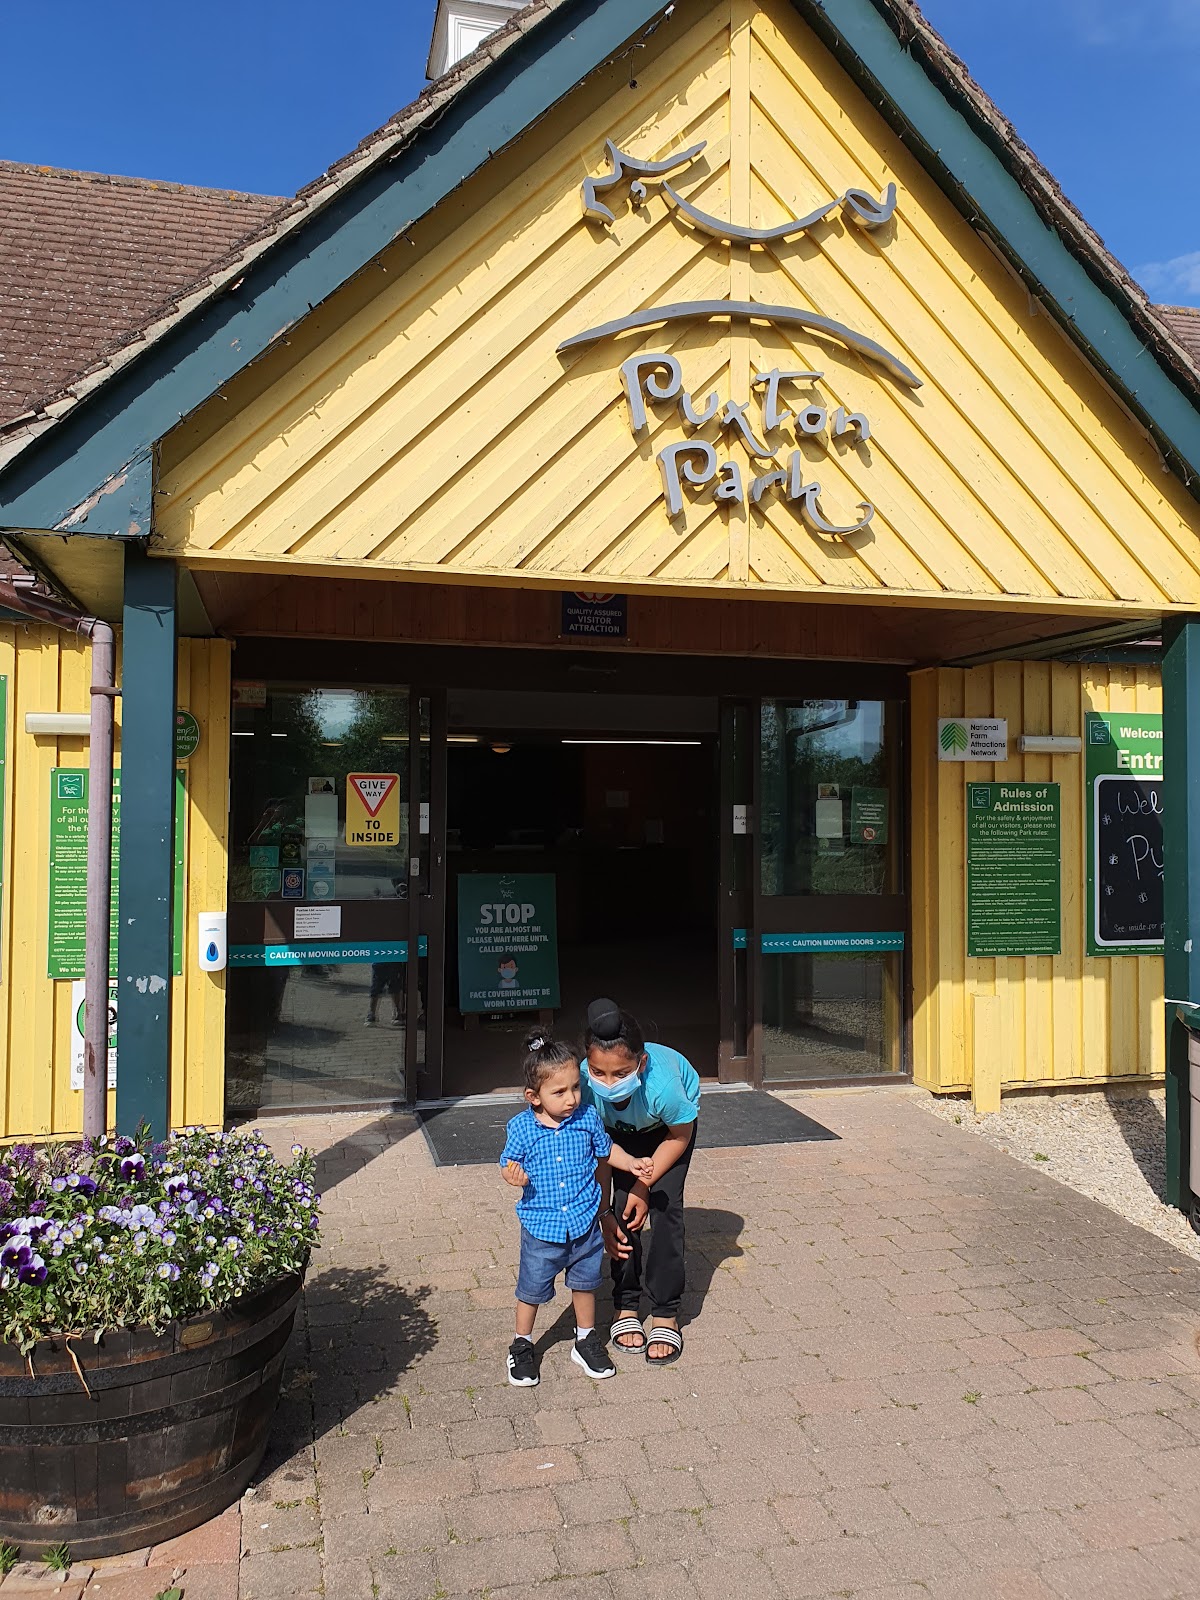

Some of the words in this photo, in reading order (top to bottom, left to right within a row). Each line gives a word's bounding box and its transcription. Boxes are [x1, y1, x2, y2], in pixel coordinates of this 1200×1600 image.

[620, 353, 872, 459] Puxton
[656, 440, 875, 534] Park
[567, 608, 593, 616] QUALITY
[594, 609, 622, 617] ASSURED
[578, 616, 612, 625] VISITOR
[569, 624, 620, 633] ATTRACTION
[359, 780, 386, 789] GIVE
[1000, 787, 1032, 798] Rules
[1035, 788, 1048, 798] of
[62, 806, 77, 814] For
[993, 802, 1054, 812] Admission
[365, 820, 381, 830] TO
[351, 832, 394, 842] INSIDE
[480, 903, 536, 925] STOP
[475, 926, 489, 934] YOU
[490, 926, 504, 934] ARE
[1113, 923, 1125, 933] See
[1128, 922, 1146, 931] inside
[1146, 923, 1158, 934] for
[467, 936, 493, 944] PLEASE
[512, 935, 529, 943] HERE
[792, 939, 822, 947] CAUTION
[823, 938, 850, 946] MOVING
[850, 938, 874, 946] DOORS
[479, 945, 504, 953] CALLED
[505, 944, 538, 953] FORWARD
[269, 951, 307, 960] CAUTION
[308, 950, 340, 958] MOVING
[340, 949, 371, 957] DOORS
[469, 990, 487, 998] FACE
[487, 989, 521, 998] COVERING
[522, 988, 541, 996] MUST
[484, 1000, 505, 1008] WORN
[506, 999, 516, 1007] TO
[516, 998, 538, 1006] ENTER
